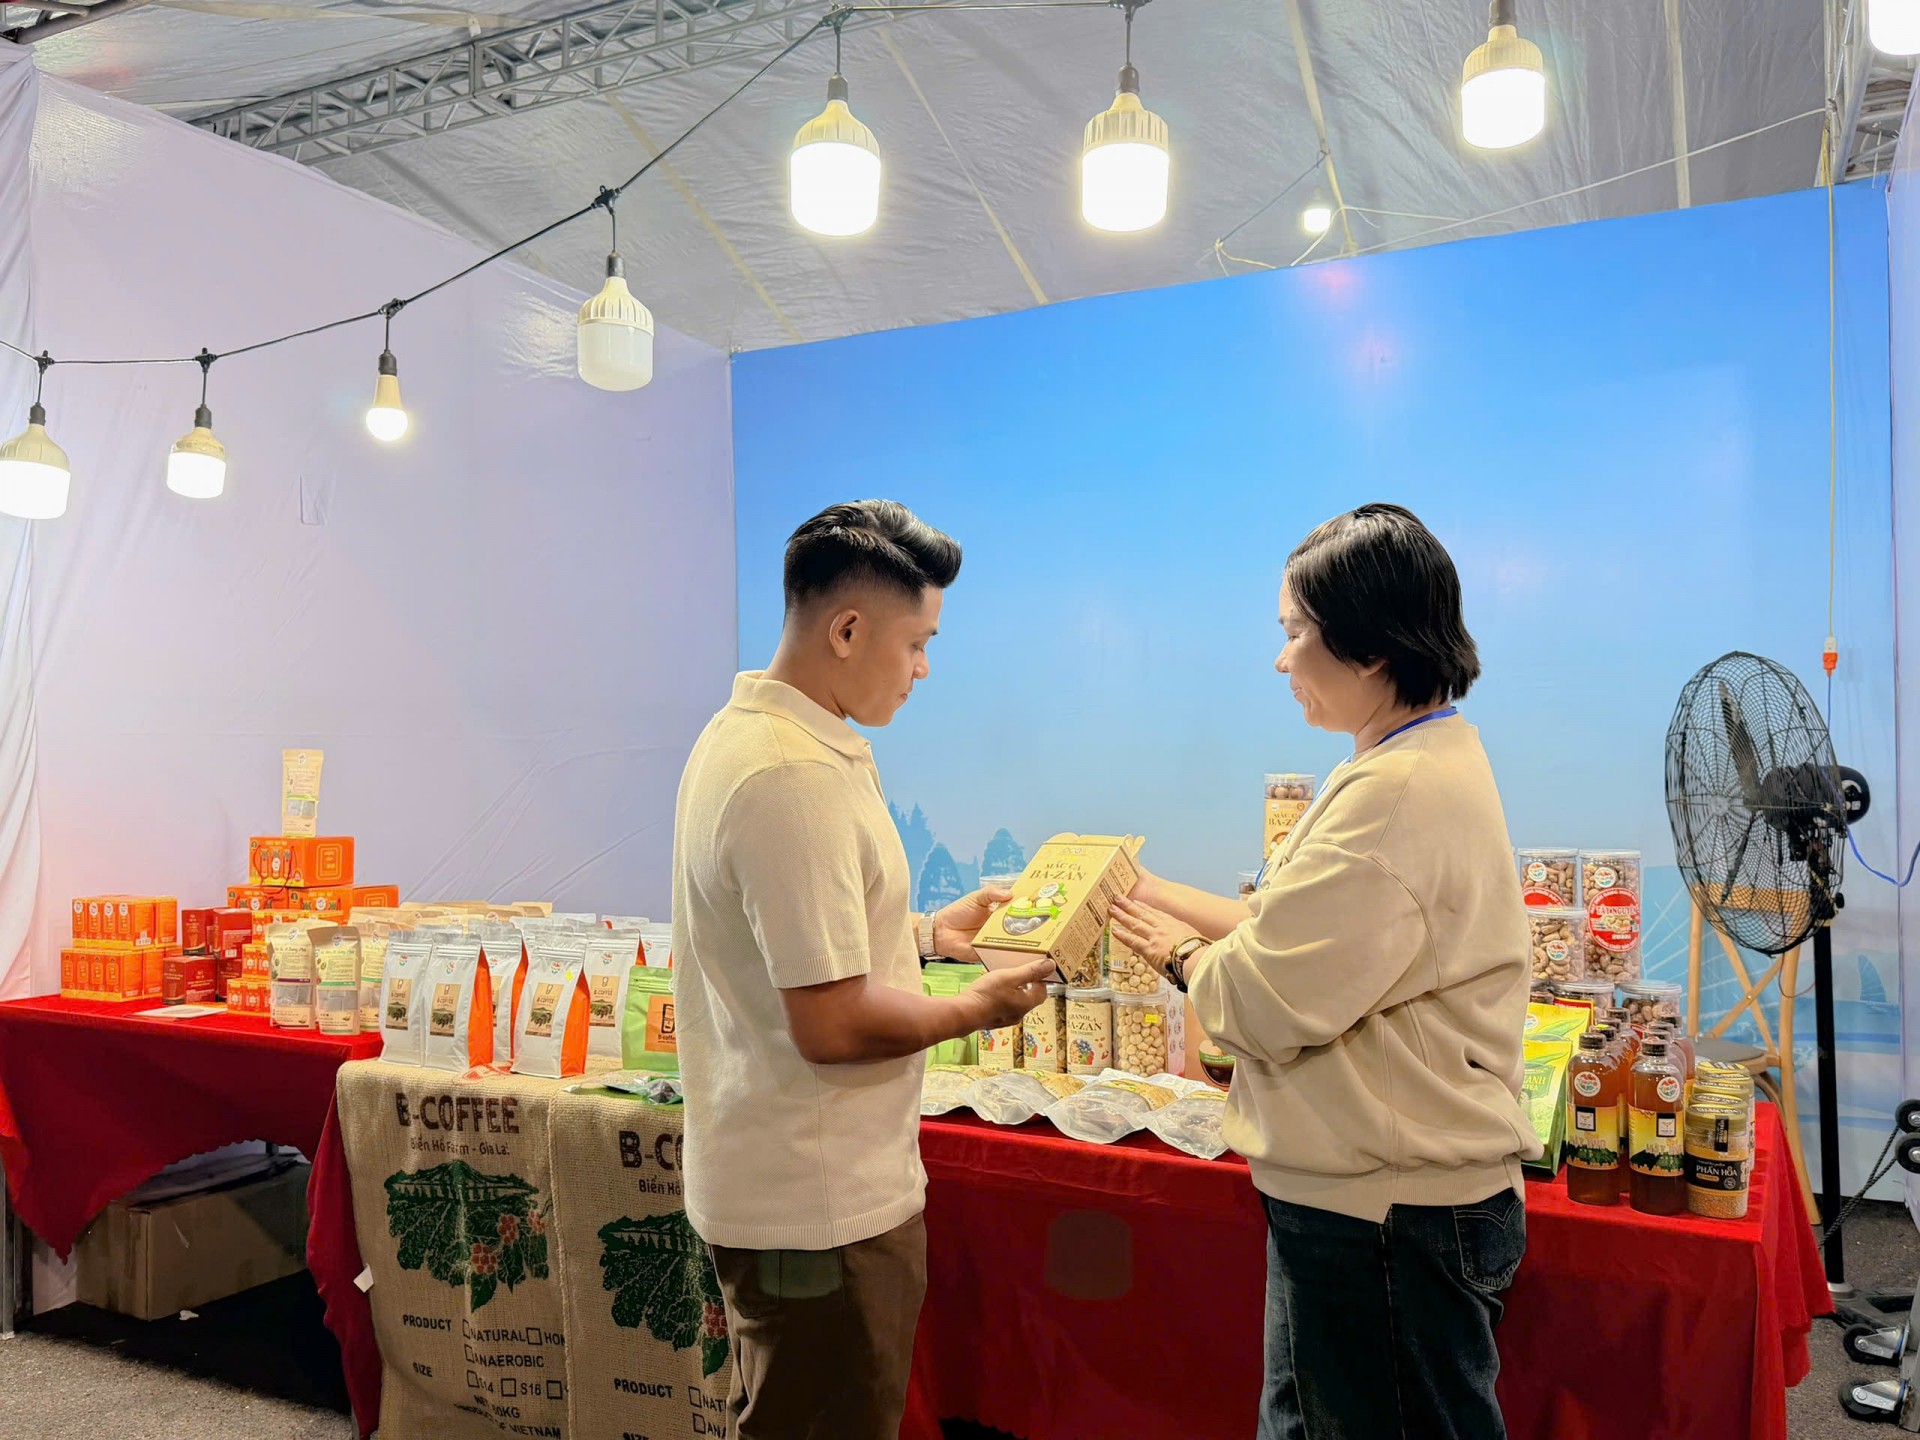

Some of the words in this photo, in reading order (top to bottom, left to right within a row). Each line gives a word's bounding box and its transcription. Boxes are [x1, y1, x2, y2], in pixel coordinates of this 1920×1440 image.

[1030, 870, 1087, 881] BA-ZAN
[1526, 1076, 1546, 1085] ANH
[395, 1092, 520, 1134] B-COFFEE
[639, 1175, 664, 1195] Biển
[403, 1314, 451, 1332] PRODUCT
[470, 1328, 526, 1342] NATURAL
[474, 1353, 545, 1368] ANAEROBIC
[413, 1362, 433, 1378] SIZE
[520, 1383, 542, 1396] S16
[613, 1378, 673, 1399] PRODUCT
[508, 1422, 562, 1439] VIETNAM
